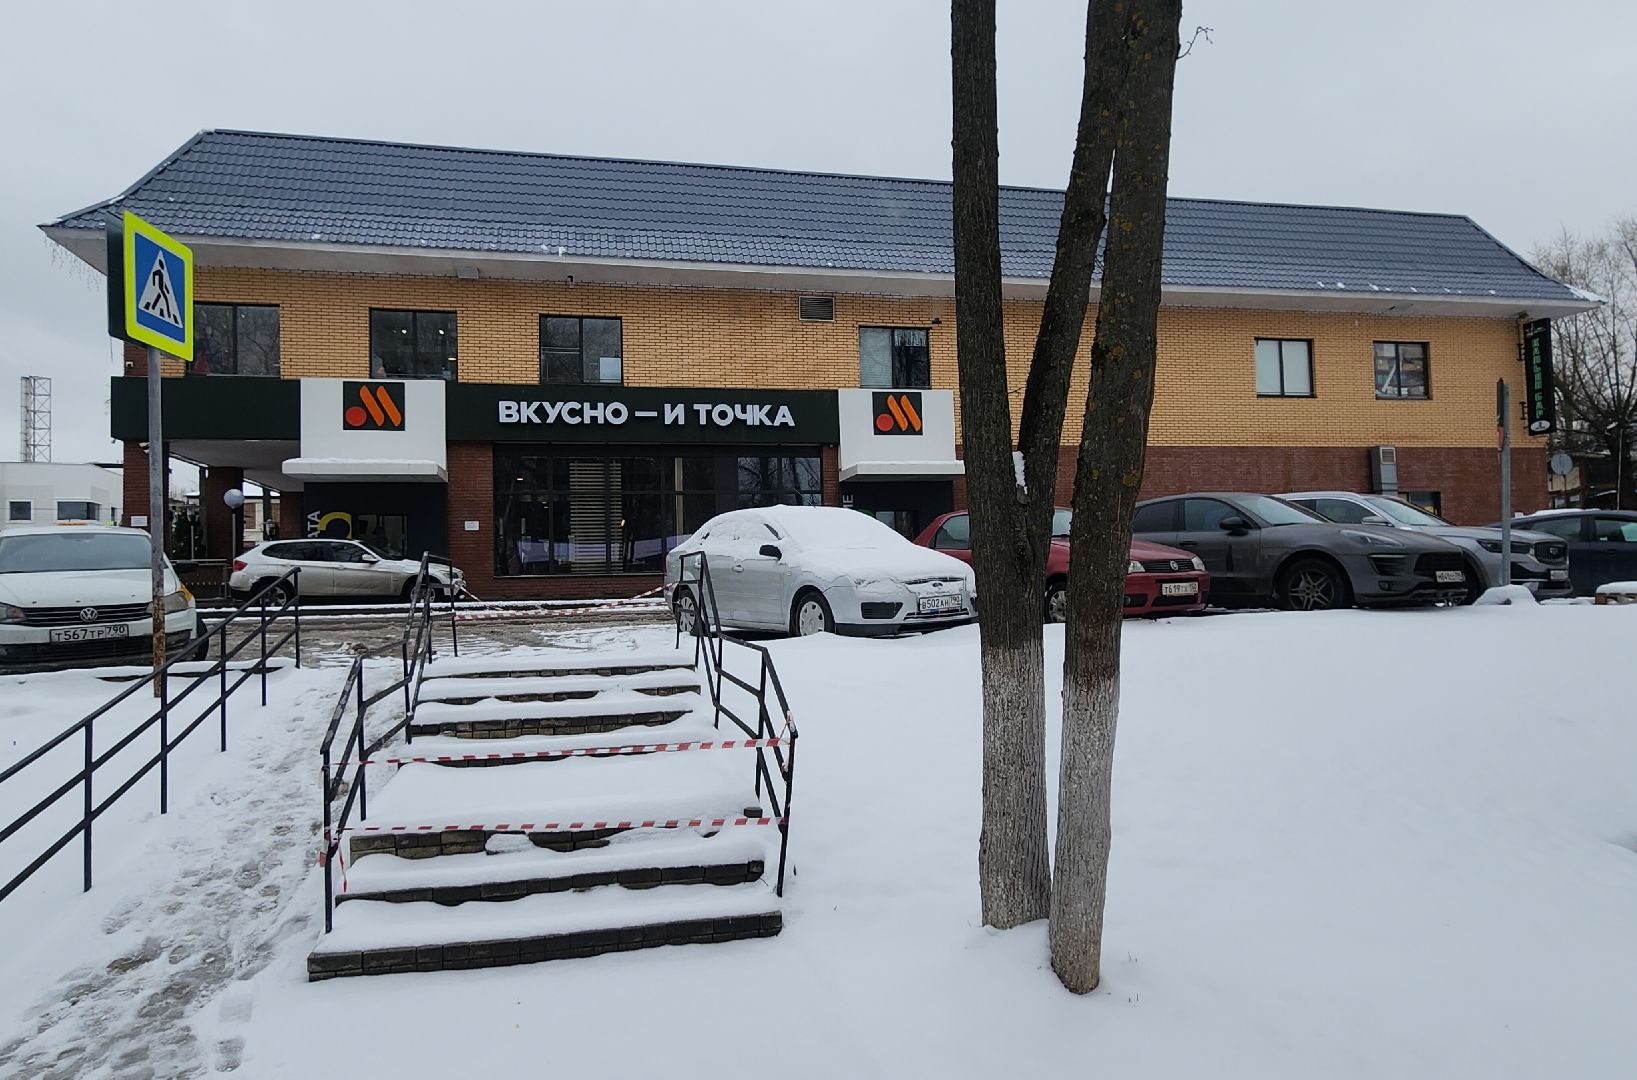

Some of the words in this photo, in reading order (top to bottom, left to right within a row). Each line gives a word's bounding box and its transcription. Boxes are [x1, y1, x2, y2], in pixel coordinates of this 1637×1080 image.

[498, 400, 629, 425] ВКУСНО
[663, 403, 686, 426] И
[693, 403, 796, 427] ТОЧКА
